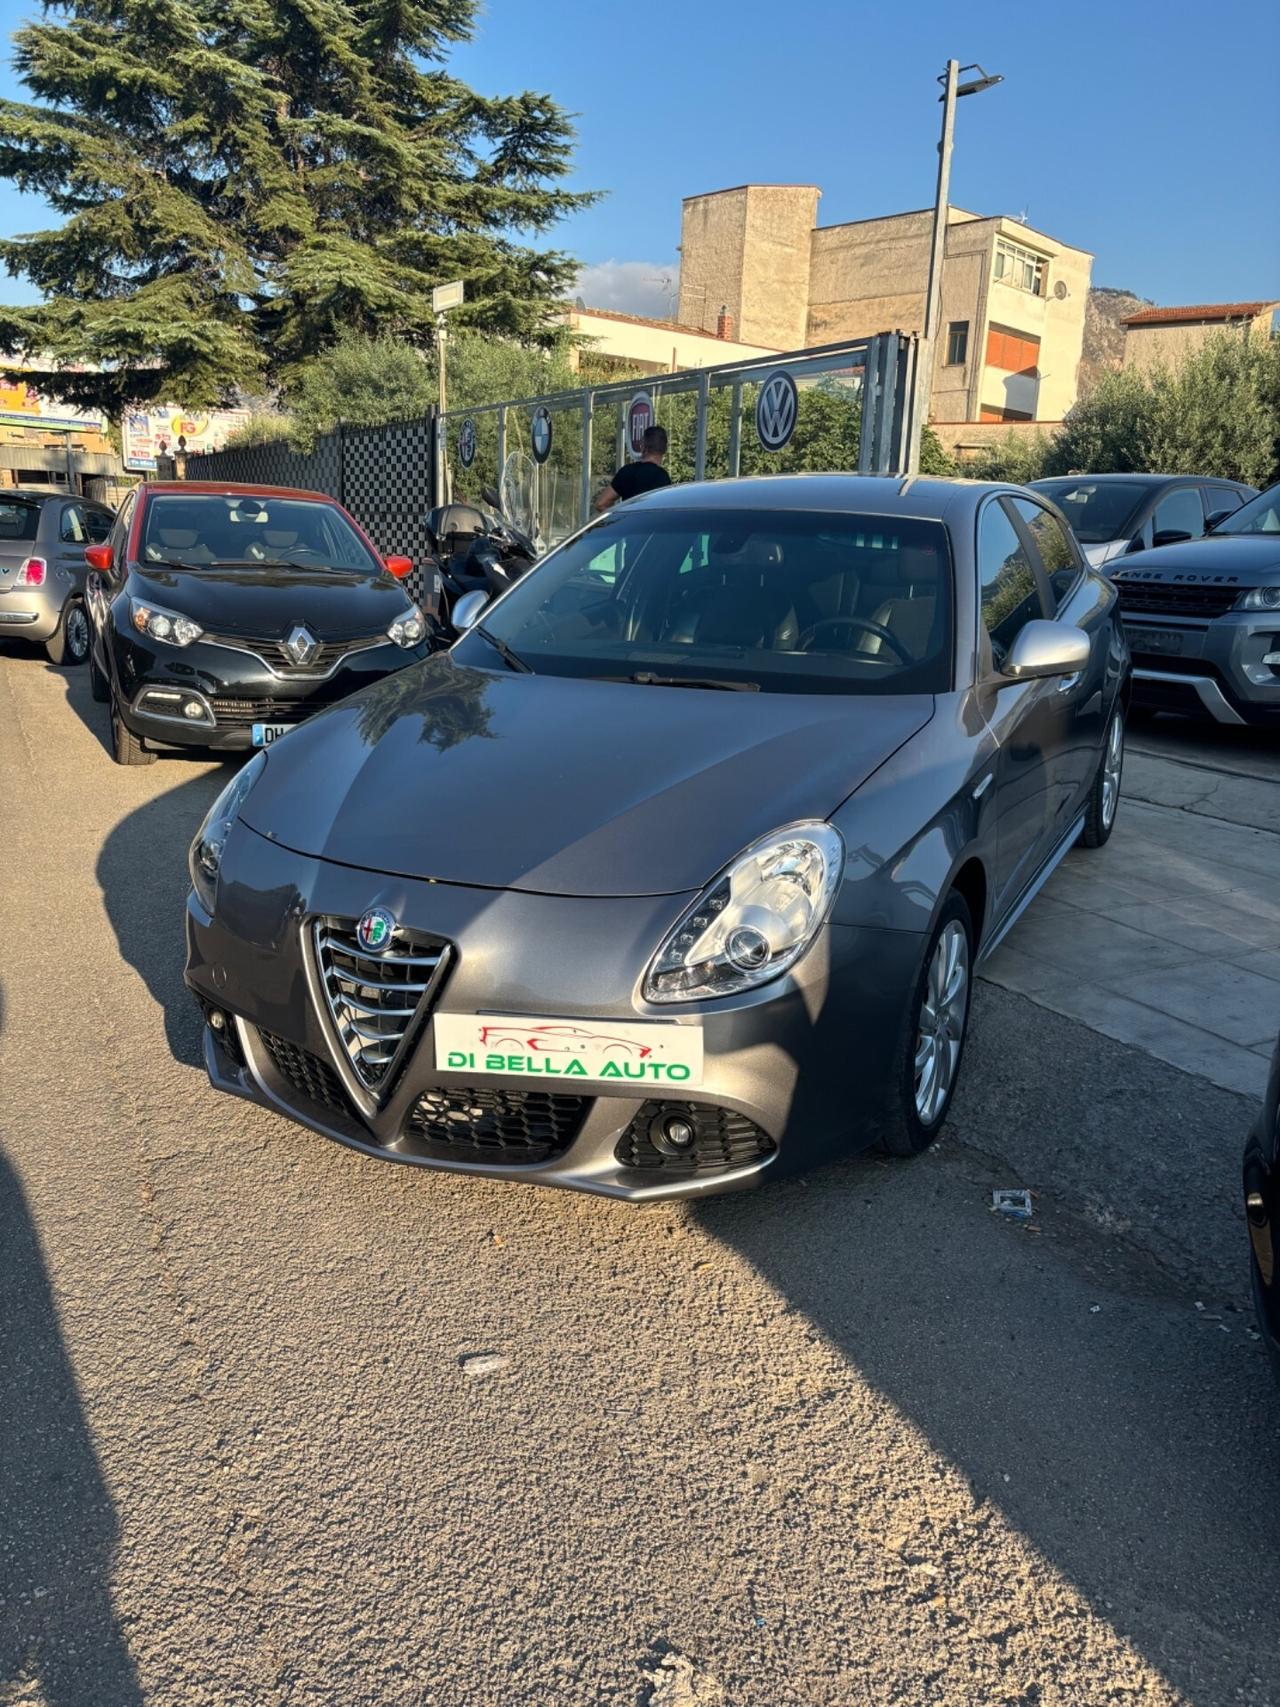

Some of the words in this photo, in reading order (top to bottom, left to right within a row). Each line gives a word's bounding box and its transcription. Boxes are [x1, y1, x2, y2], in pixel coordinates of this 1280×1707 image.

[1111, 570, 1163, 579] RANGE
[1174, 574, 1240, 583] ROVER
[447, 1051, 476, 1069] DI
[485, 1053, 588, 1076] BELLA
[598, 1060, 691, 1082] AUTO
